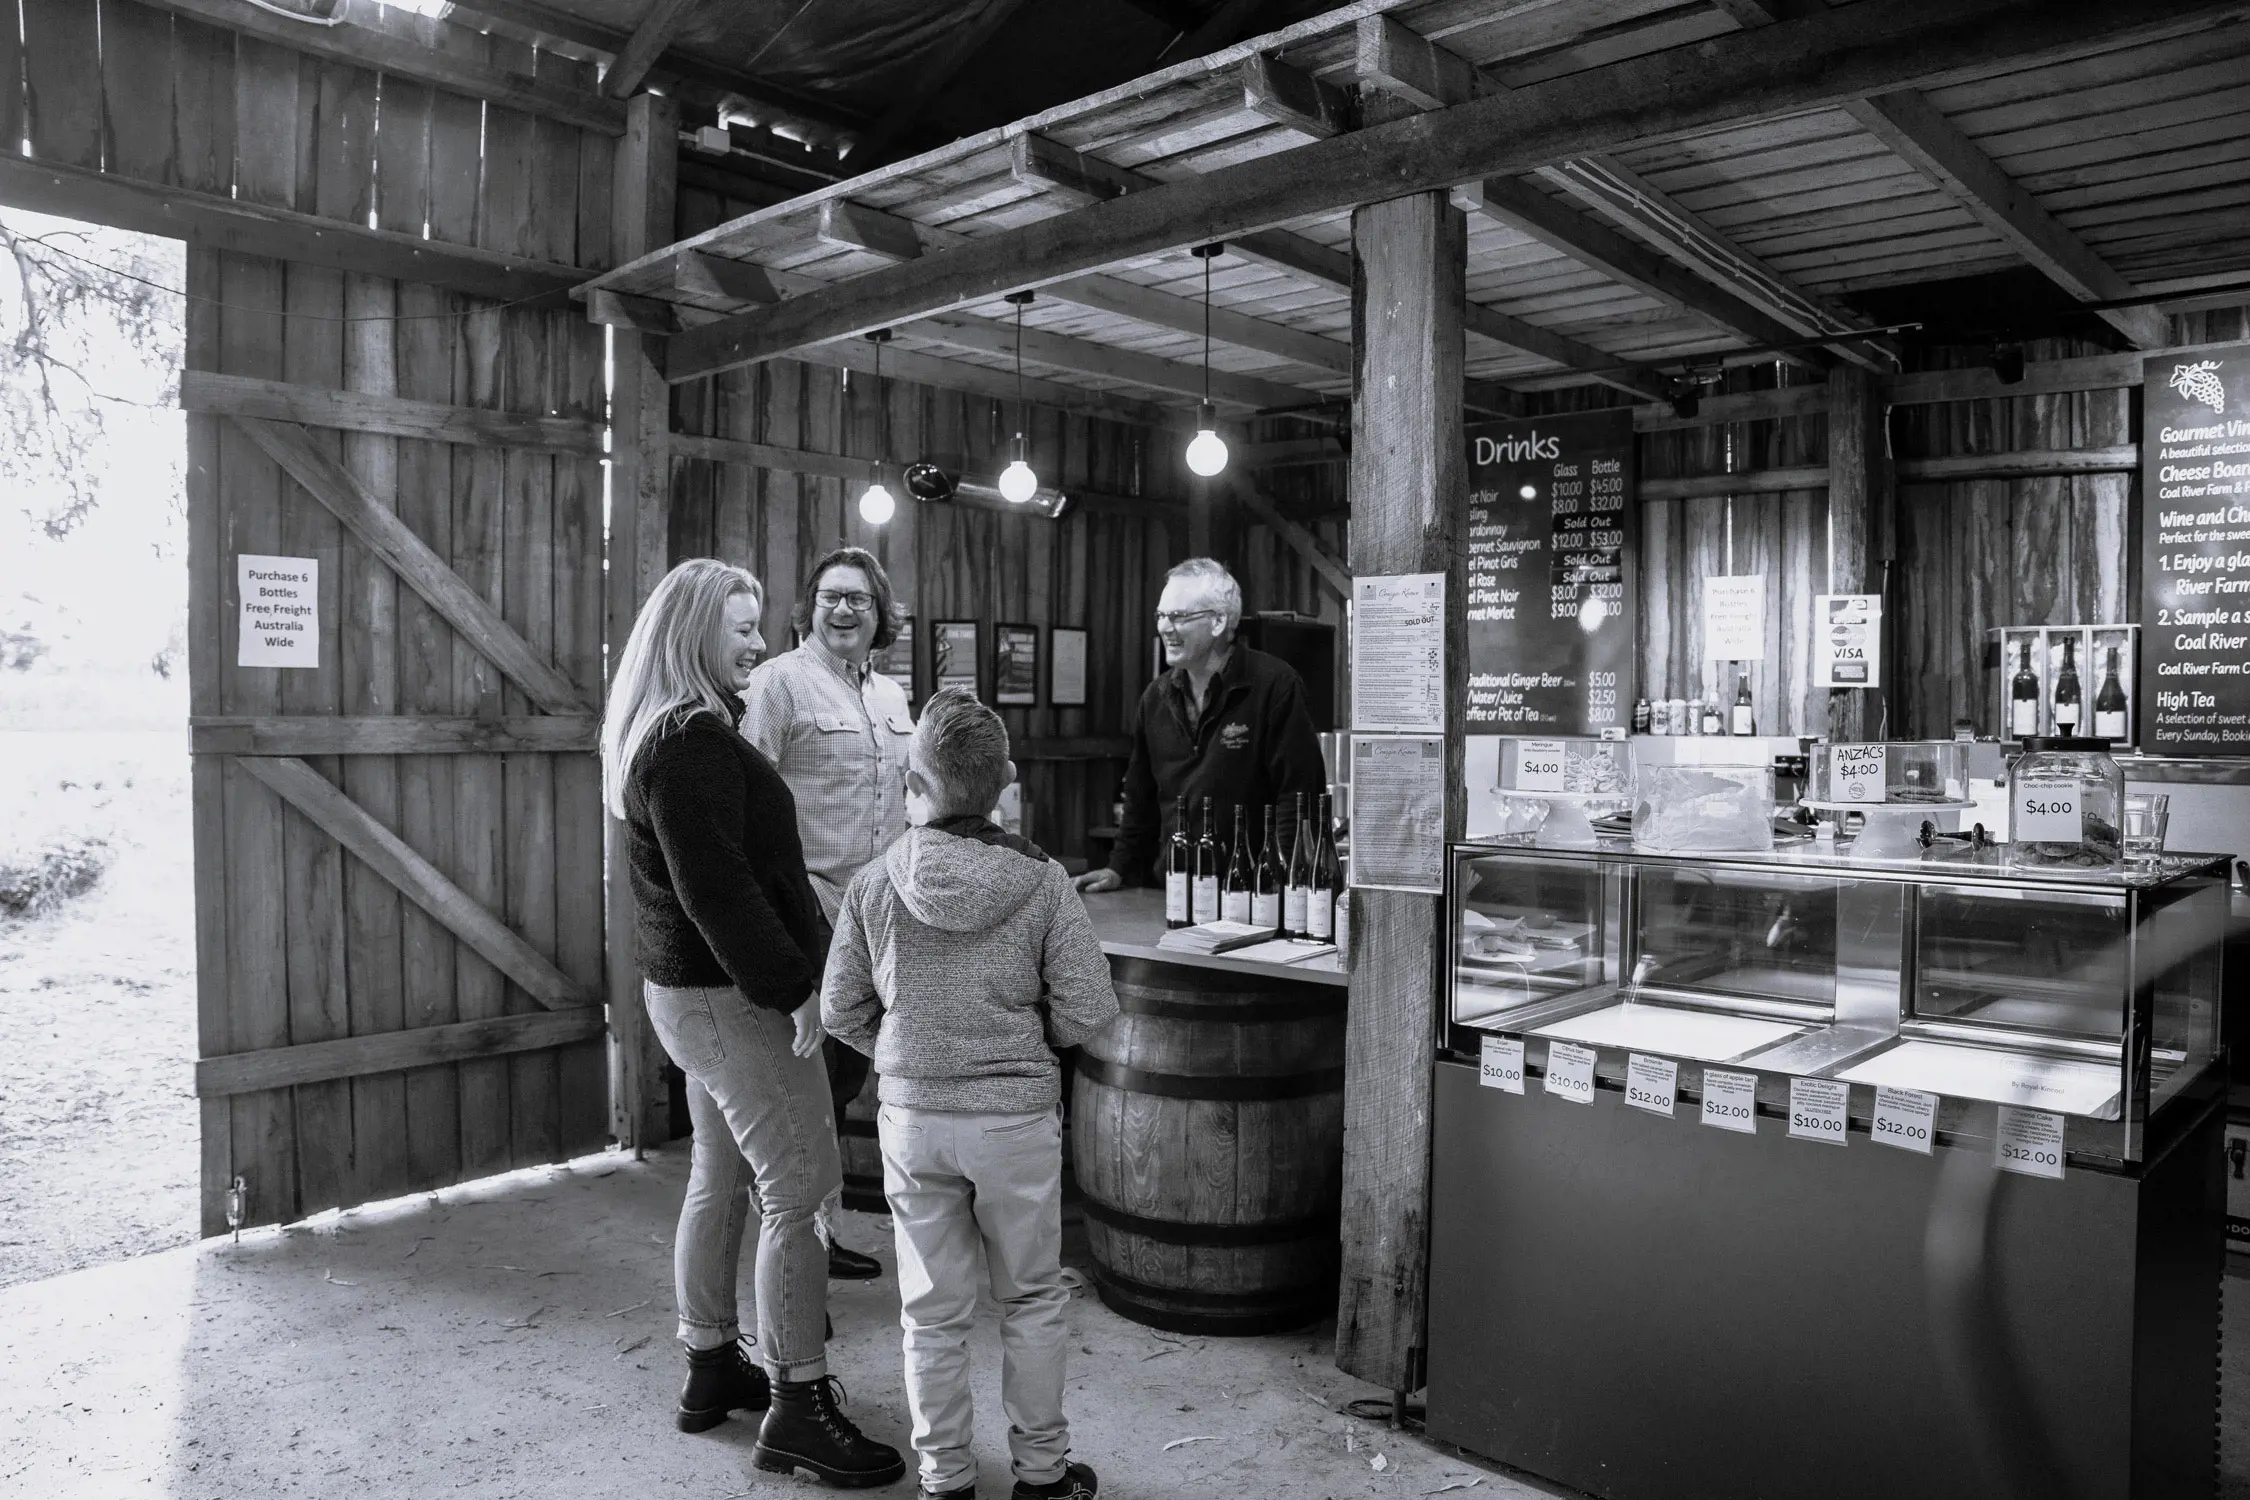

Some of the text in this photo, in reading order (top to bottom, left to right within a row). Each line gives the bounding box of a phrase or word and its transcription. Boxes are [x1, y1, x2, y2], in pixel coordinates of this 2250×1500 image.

[2161, 423, 2225, 443] Gourmet
[1475, 430, 1560, 465] Drinks
[2159, 448, 2167, 459] A
[2169, 444, 2210, 459] beautiful
[1554, 459, 1620, 477] Glass Bottle
[2160, 465, 2210, 482] Cheese
[1481, 490, 1499, 503] Noir
[1551, 481, 1582, 497] $10.00
[1590, 478, 1622, 495] $45.00
[2160, 485, 2180, 499] Coal
[2182, 485, 2206, 497] River
[2207, 483, 2232, 495] Farm
[2234, 482, 2242, 493] &
[1552, 499, 1577, 516] $8.00
[1590, 496, 1622, 511] $32.00
[1564, 517, 1587, 529] Sold
[1591, 517, 1611, 527] Out
[2160, 511, 2194, 527] Wine
[2196, 507, 2225, 525] and
[1496, 538, 1540, 554] Sauvignon
[1551, 533, 1582, 549] $12.00
[1590, 531, 1622, 547] $53.00
[2159, 531, 2192, 544] Perfect
[2194, 530, 2207, 542] for
[2209, 530, 2225, 541] the
[1478, 556, 1499, 569] Pinot
[1501, 555, 1518, 569] Gris
[1564, 554, 1586, 566] Sold
[1591, 553, 1611, 564] Out
[2159, 555, 2170, 571] 1.
[2174, 554, 2213, 574] Enjoy
[2215, 556, 2225, 568] a
[249, 570, 308, 582] Purchase 6
[1478, 573, 1495, 586] Rose
[1563, 571, 1585, 583] Sold
[1590, 571, 1610, 581] Out
[260, 588, 298, 598] Bottles
[1477, 589, 1499, 603] Pinot
[1501, 588, 1520, 602] Noir
[1551, 585, 1577, 600] $8.00
[1590, 584, 1622, 599] $32.00
[2176, 577, 2250, 595] River Farm
[246, 604, 311, 617] Free Freight
[1487, 606, 1515, 620] Merlot
[1551, 603, 1577, 619] $9.00
[2158, 609, 2171, 625] 2.
[2174, 607, 2229, 629] Sample
[2231, 611, 2240, 623] a
[255, 621, 303, 631] Australia
[1405, 618, 1420, 626] SOLD
[265, 638, 294, 647] Wide
[2175, 632, 2247, 650] Coal River
[1834, 648, 1863, 658] VISA
[2158, 662, 2181, 675] Coal
[2183, 662, 2210, 674] River
[2212, 662, 2240, 674] Farm
[1511, 673, 1540, 690] Ginger
[1542, 673, 1562, 687] Beer
[1589, 671, 1615, 688] $5.00
[1589, 689, 1615, 705] $2.50
[2157, 691, 2215, 711] High Tea
[1488, 711, 1496, 721] or
[1499, 706, 1512, 721] Pot
[1514, 706, 1525, 721] of
[1525, 707, 1538, 721] Tea
[1588, 707, 1615, 723] $8.00
[2156, 713, 2163, 723] A
[2165, 713, 2205, 724] selection
[2207, 712, 2217, 724] of
[2218, 715, 2246, 724] sweet
[2156, 729, 2182, 743] Every
[2184, 729, 2219, 743] Sunday,
[1525, 760, 1558, 774] $4.00
[2026, 799, 2072, 815] $4.00
[1483, 1064, 1520, 1081] $10.00
[1710, 1072, 1723, 1080] glass
[1729, 1075, 1743, 1083] apple
[1550, 1073, 1589, 1092] $10.00
[1817, 1082, 1838, 1090] Delight
[2011, 1081, 2019, 1089] By
[1629, 1088, 1670, 1107] $12.00
[1887, 1088, 1923, 1100] Black Forest
[1706, 1100, 1749, 1119] $12.00
[2037, 1112, 2053, 1121] Cake
[1794, 1113, 1842, 1132] $10.00
[1877, 1116, 1927, 1140] $12.00
[2001, 1143, 2057, 1166] $12.00
